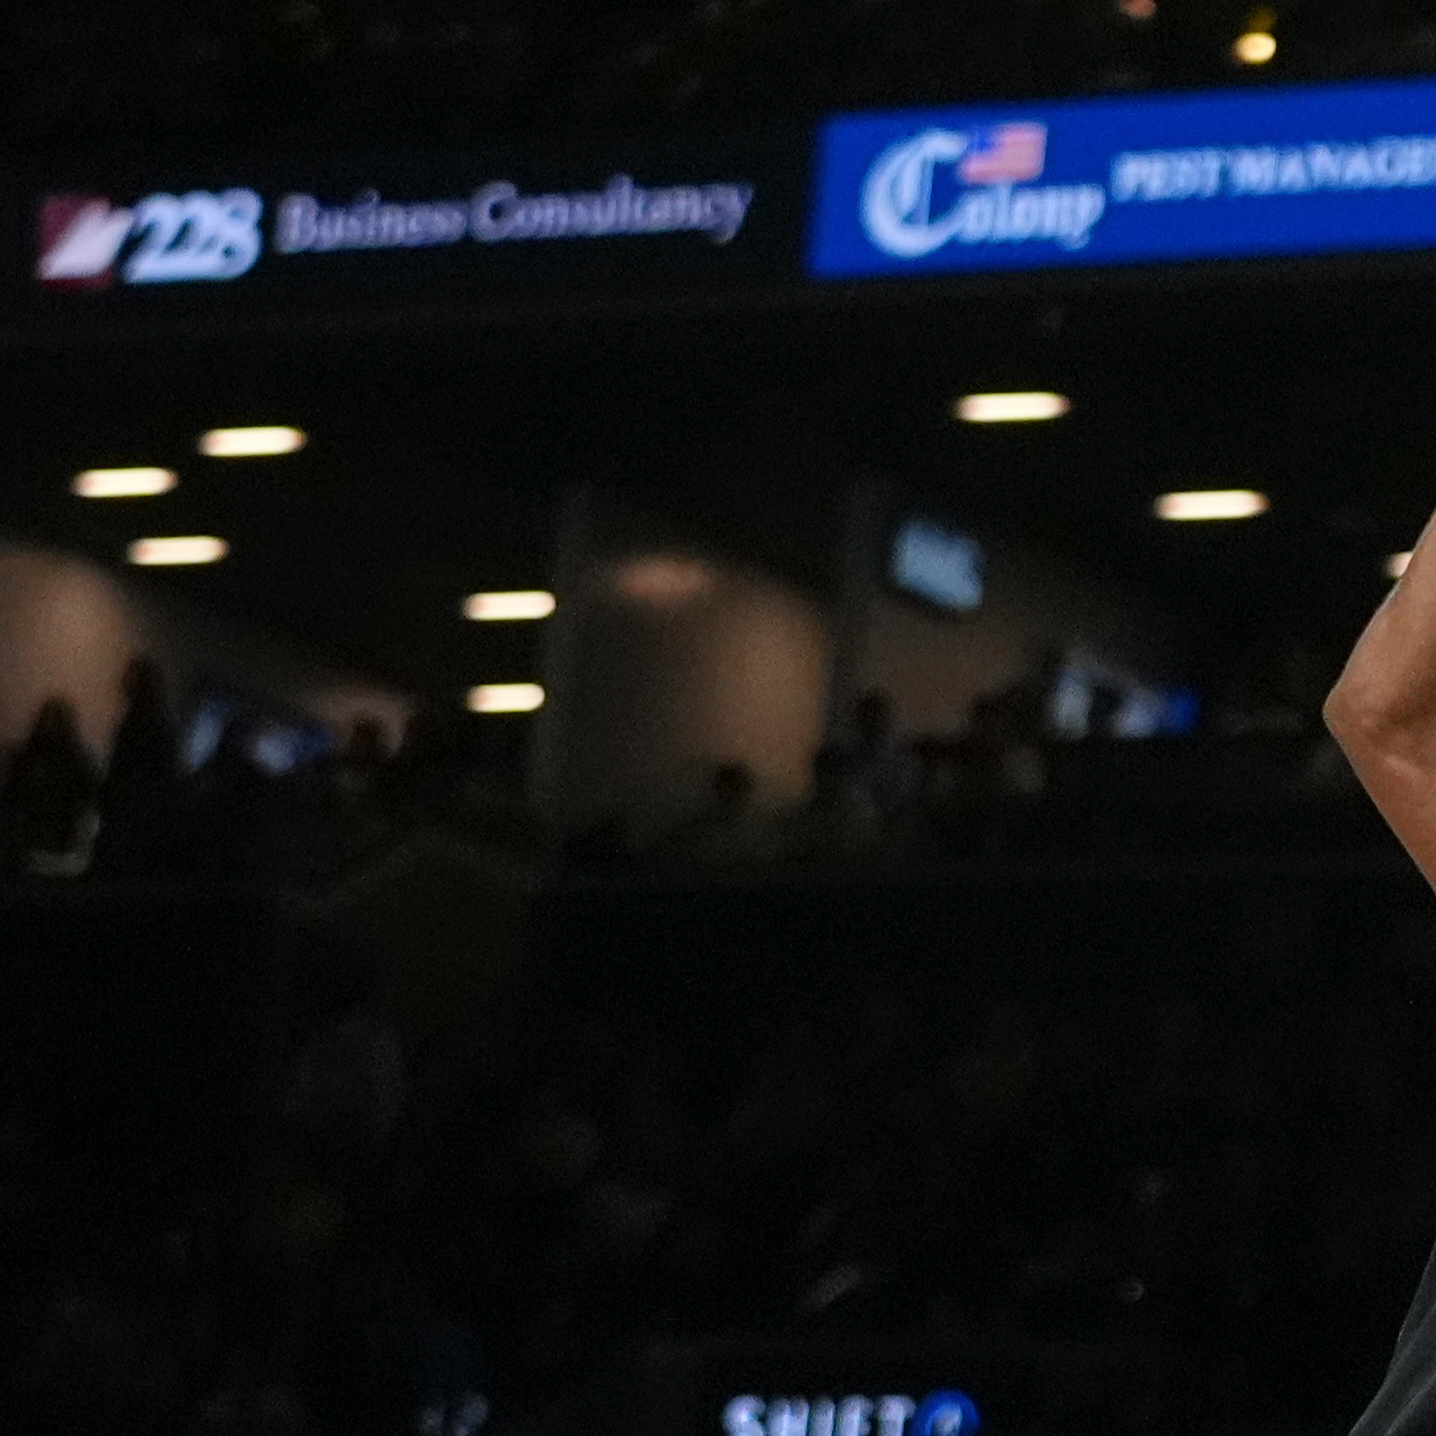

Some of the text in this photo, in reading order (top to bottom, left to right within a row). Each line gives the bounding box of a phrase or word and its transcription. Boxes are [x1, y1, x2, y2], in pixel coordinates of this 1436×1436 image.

[276, 191, 465, 254] Business
[470, 174, 754, 245] Consultancy
[861, 126, 1106, 258] Colony
[1111, 147, 1227, 204] PEST
